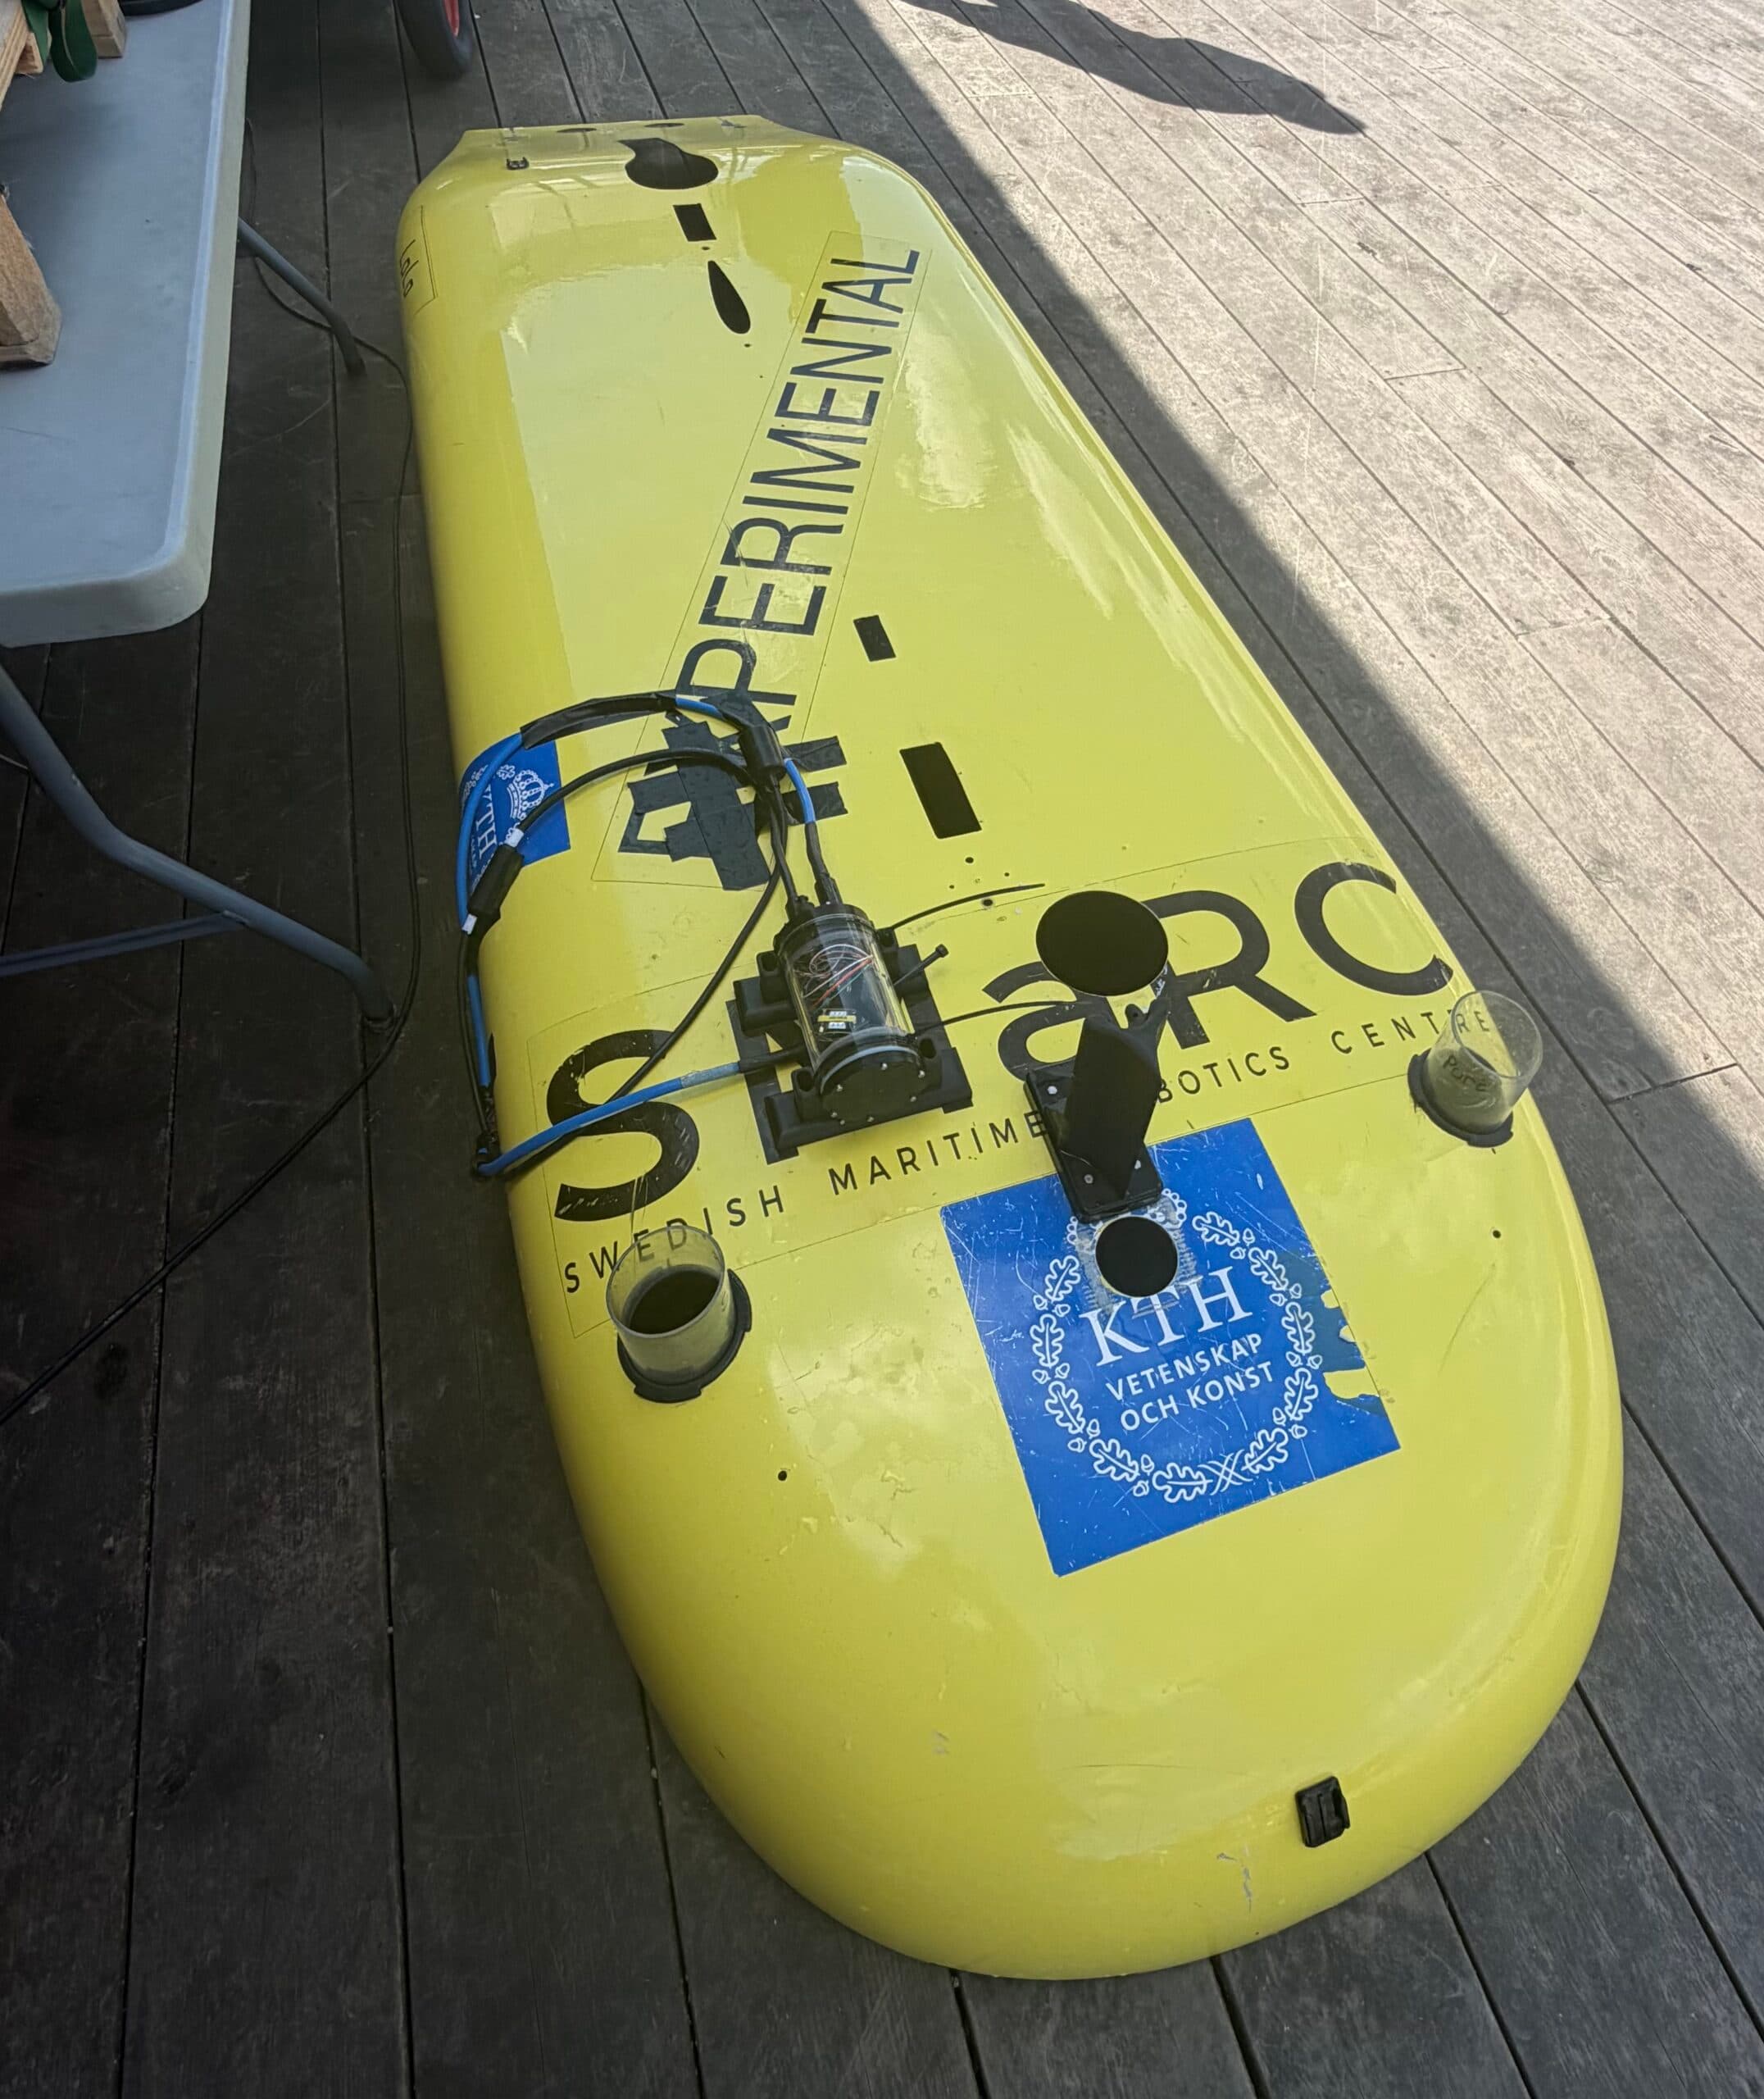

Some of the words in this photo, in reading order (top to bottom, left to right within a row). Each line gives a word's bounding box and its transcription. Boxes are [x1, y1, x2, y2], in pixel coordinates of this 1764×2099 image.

[618, 248, 921, 854] PERIMENTAL
[564, 1185, 784, 1293] SWEDISH
[1156, 1046, 1290, 1104] BOTICS
[1330, 1010, 1490, 1054] CENTRE
[1078, 1265, 1253, 1367] KTH
[1105, 1332, 1262, 1401] VETENSKAP
[1120, 1394, 1180, 1431] OCH
[1186, 1360, 1273, 1409] KONST
